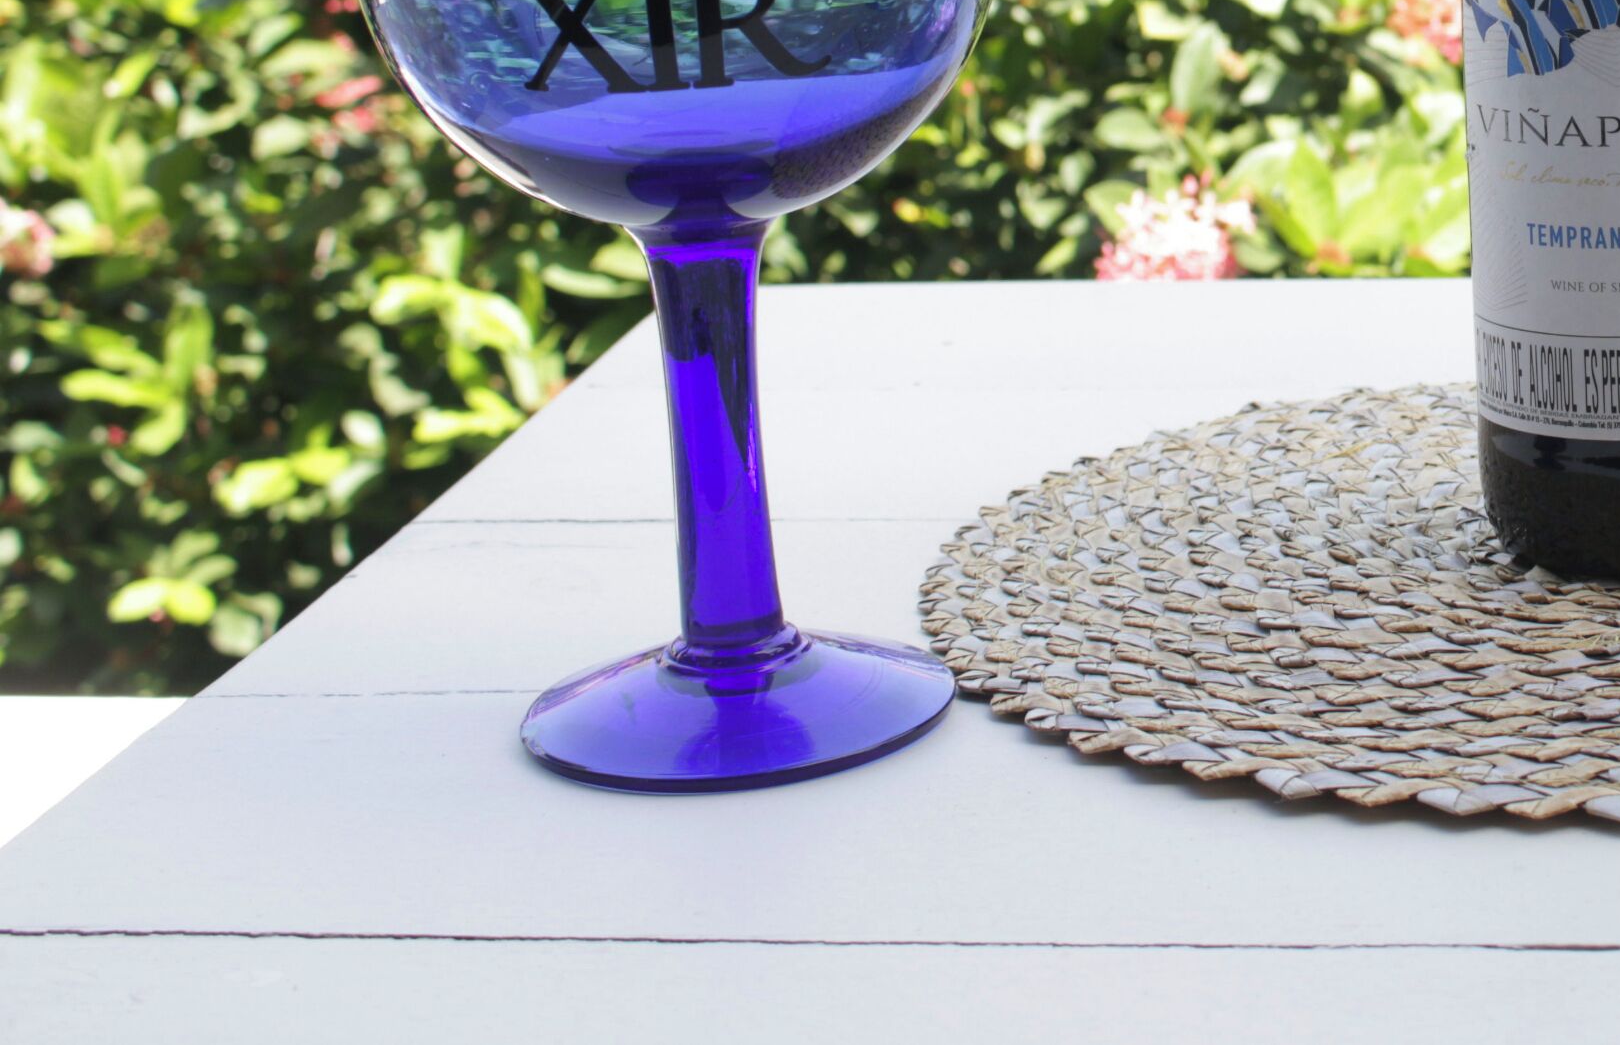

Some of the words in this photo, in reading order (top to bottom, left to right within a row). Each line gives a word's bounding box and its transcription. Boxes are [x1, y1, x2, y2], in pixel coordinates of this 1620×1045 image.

[1551, 279, 1585, 293] WINE
[1588, 282, 1607, 293] OF
[1511, 341, 1524, 405] DE
[1529, 344, 1577, 413] ALCOHOL
[1584, 348, 1599, 415] ES
